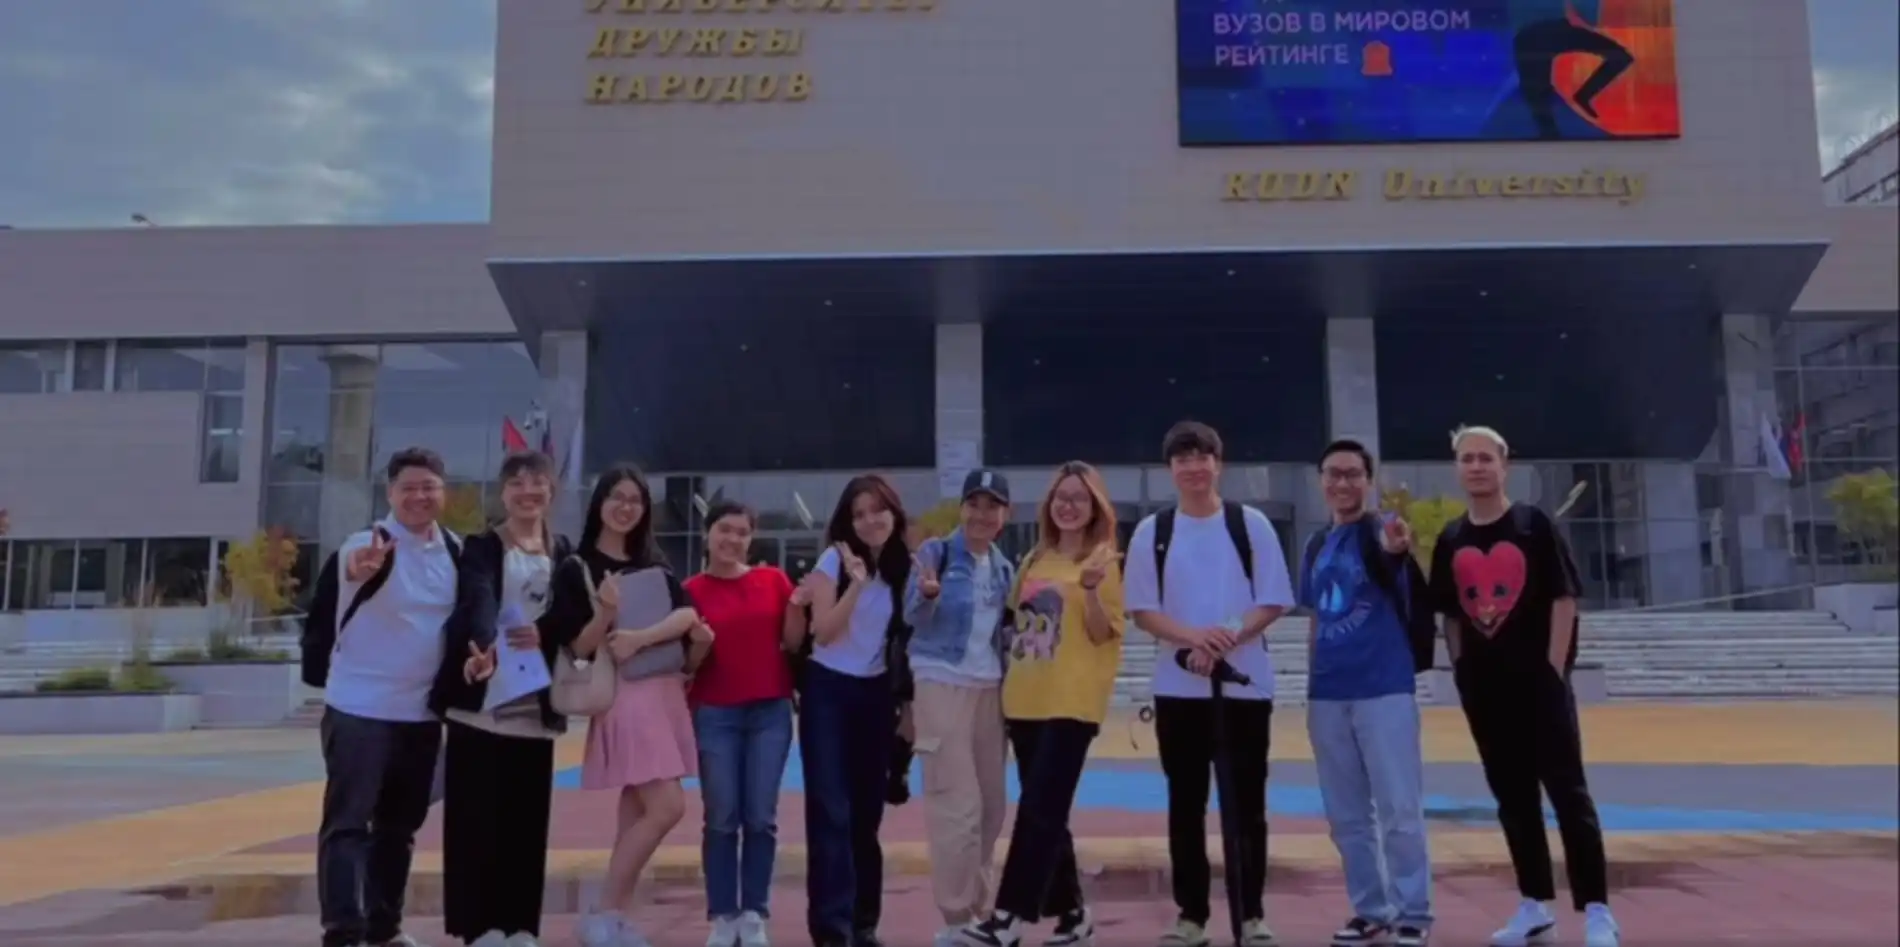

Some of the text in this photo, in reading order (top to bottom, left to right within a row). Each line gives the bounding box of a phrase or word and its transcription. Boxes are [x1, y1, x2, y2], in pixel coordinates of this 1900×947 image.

[1213, 9, 1471, 35] ВУЗОВ В МИРОВОМ
[588, 27, 803, 58] ДРУЖБЫ
[1214, 40, 1350, 67] РЕЙТИНГЕ
[585, 73, 814, 104] НАРОДОВ
[1220, 167, 1648, 206] RUDN University
